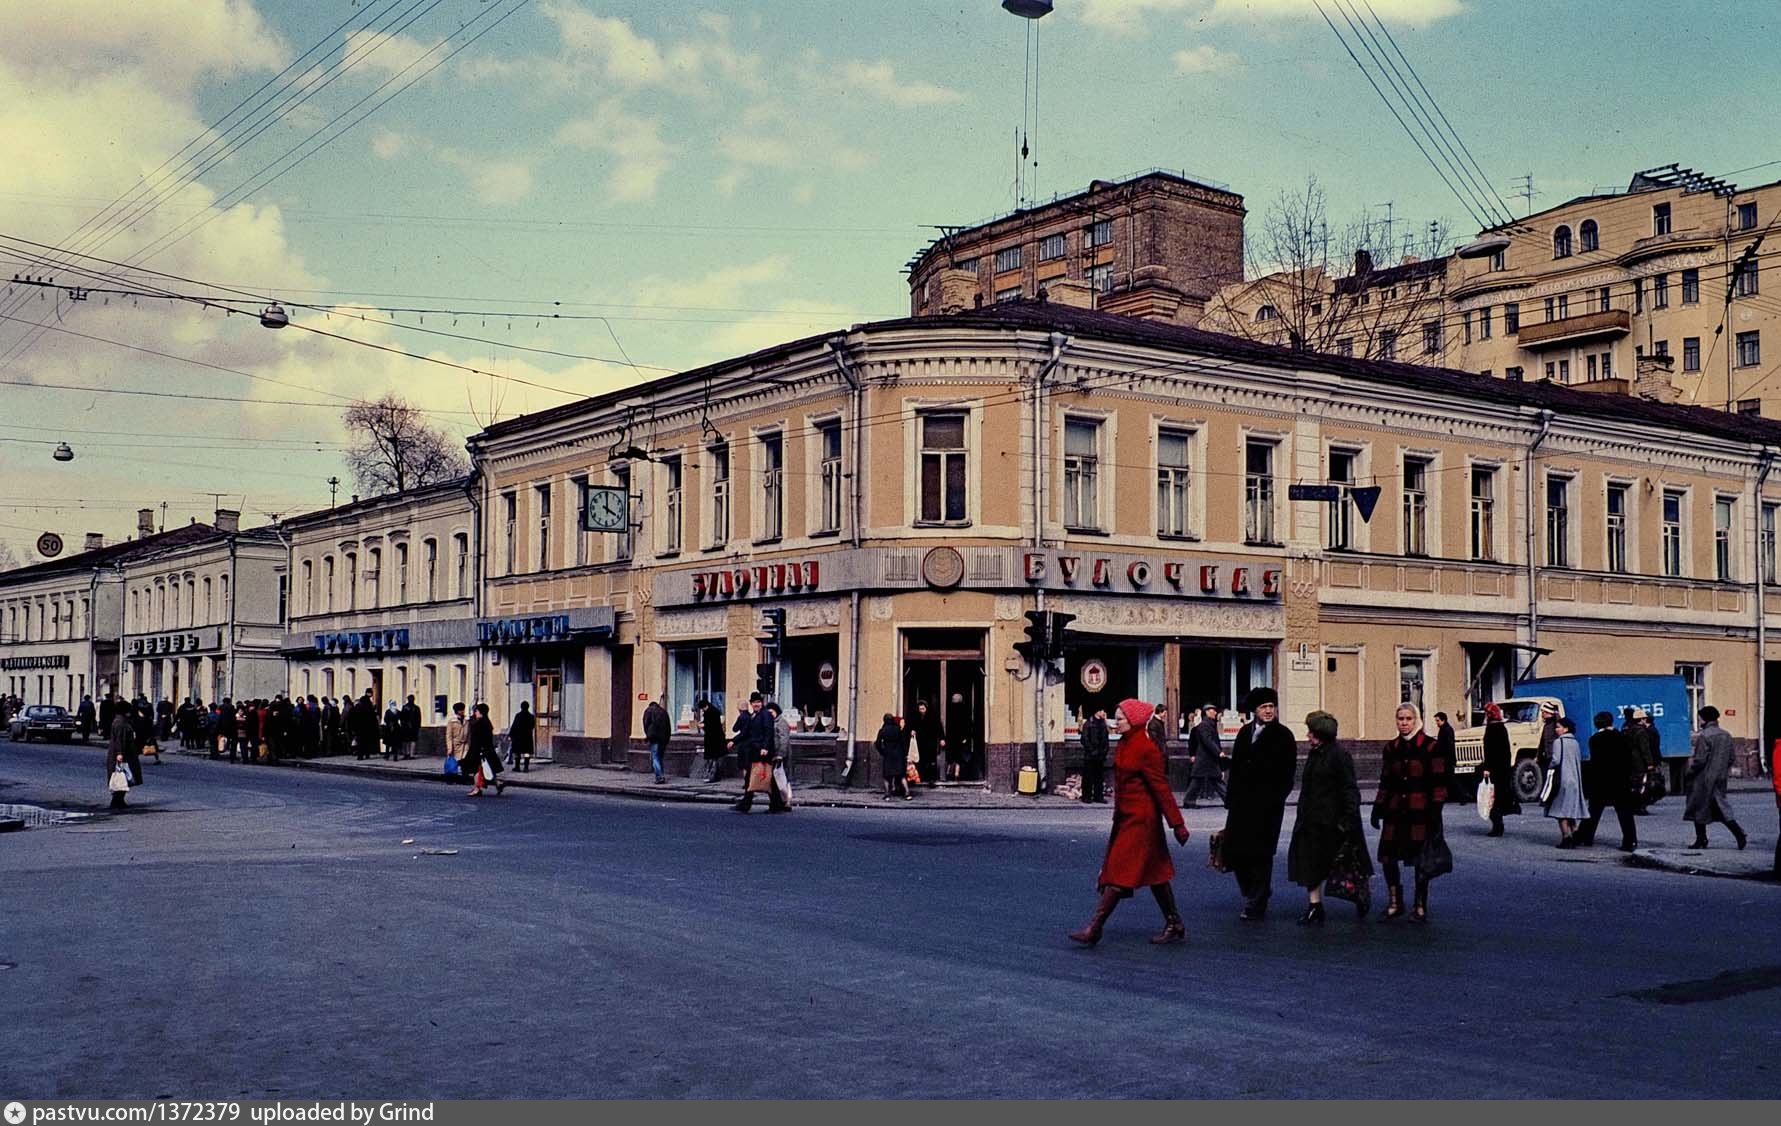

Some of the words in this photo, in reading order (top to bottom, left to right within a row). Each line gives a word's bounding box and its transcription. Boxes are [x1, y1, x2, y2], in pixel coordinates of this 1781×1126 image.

[42, 539, 59, 551] 50
[690, 561, 819, 599] БУЛОЧНАЯ
[1023, 553, 1282, 596] БУЛОЧНАЯ
[476, 615, 570, 641] ПРОДУКТЫ
